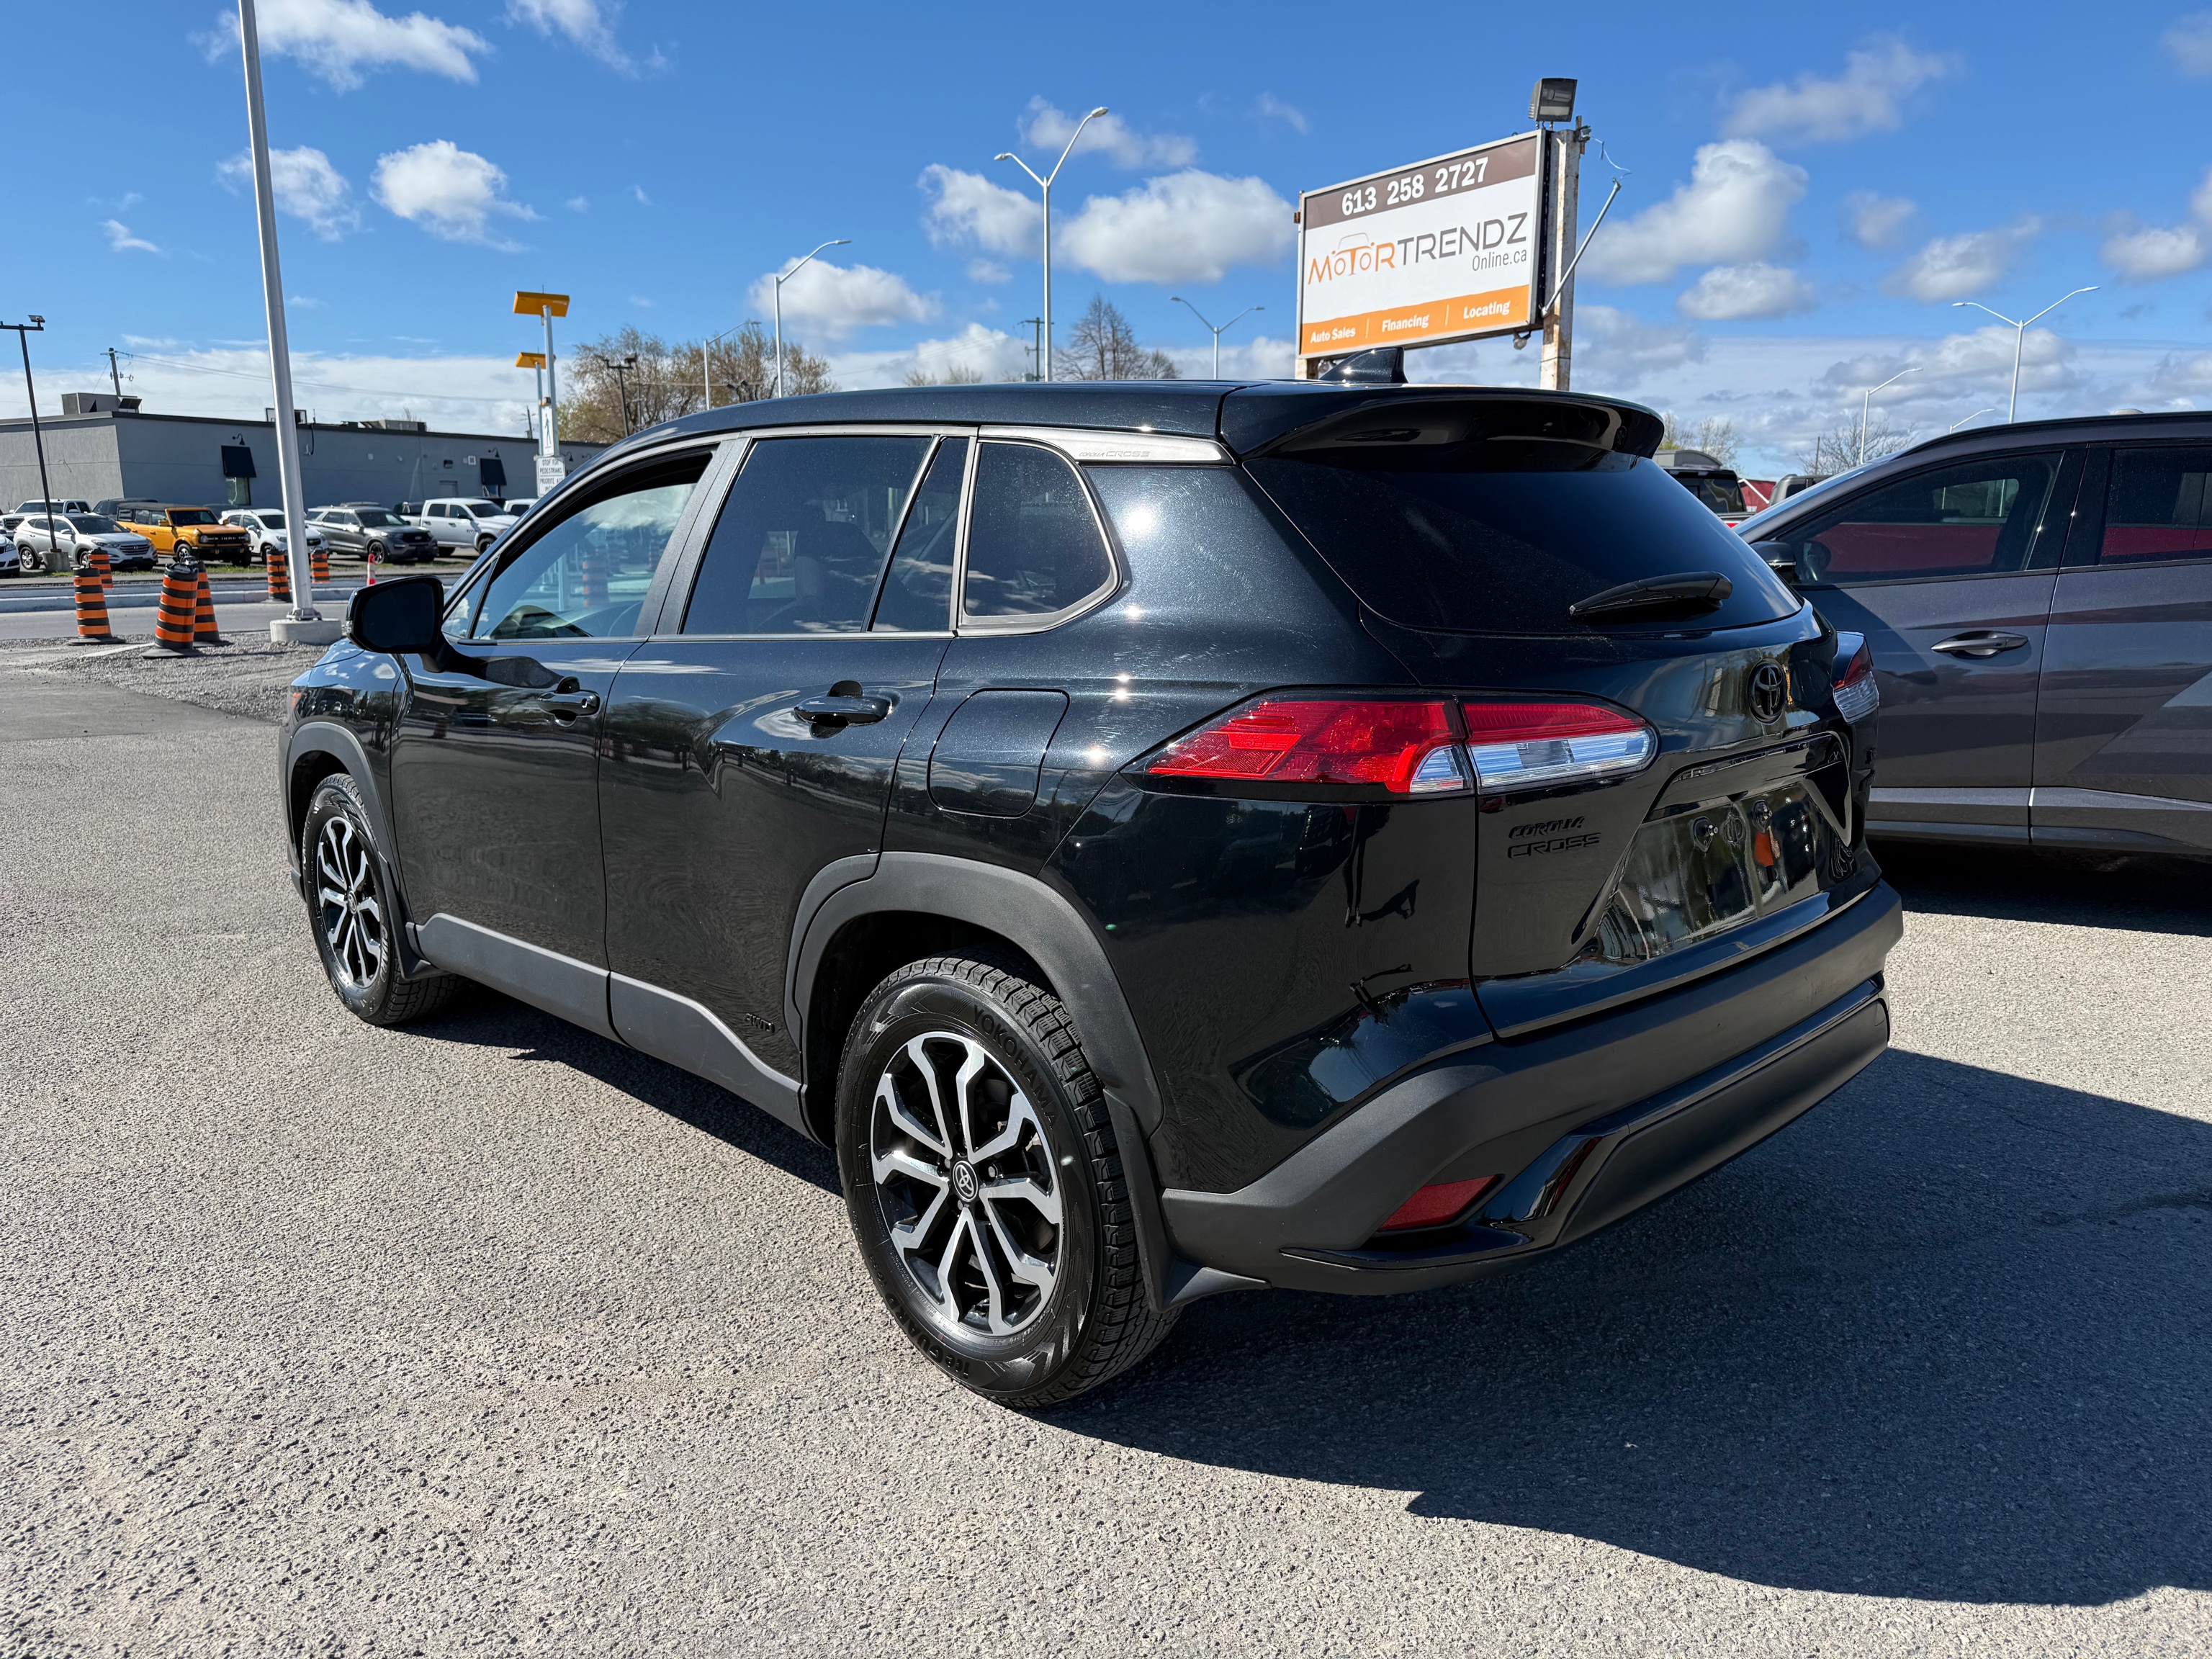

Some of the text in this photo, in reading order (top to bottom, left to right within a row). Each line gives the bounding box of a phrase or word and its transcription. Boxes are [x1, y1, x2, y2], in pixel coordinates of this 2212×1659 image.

[1341, 156, 1488, 215] 613 258 2727
[1472, 248, 1527, 272] Online.ca
[1310, 300, 1511, 343] Auto Sales Financing Locating
[1507, 832, 1601, 859] CROSS
[1509, 816, 1586, 840] COROLLA
[973, 1004, 1061, 1130] YOKOHAMA
